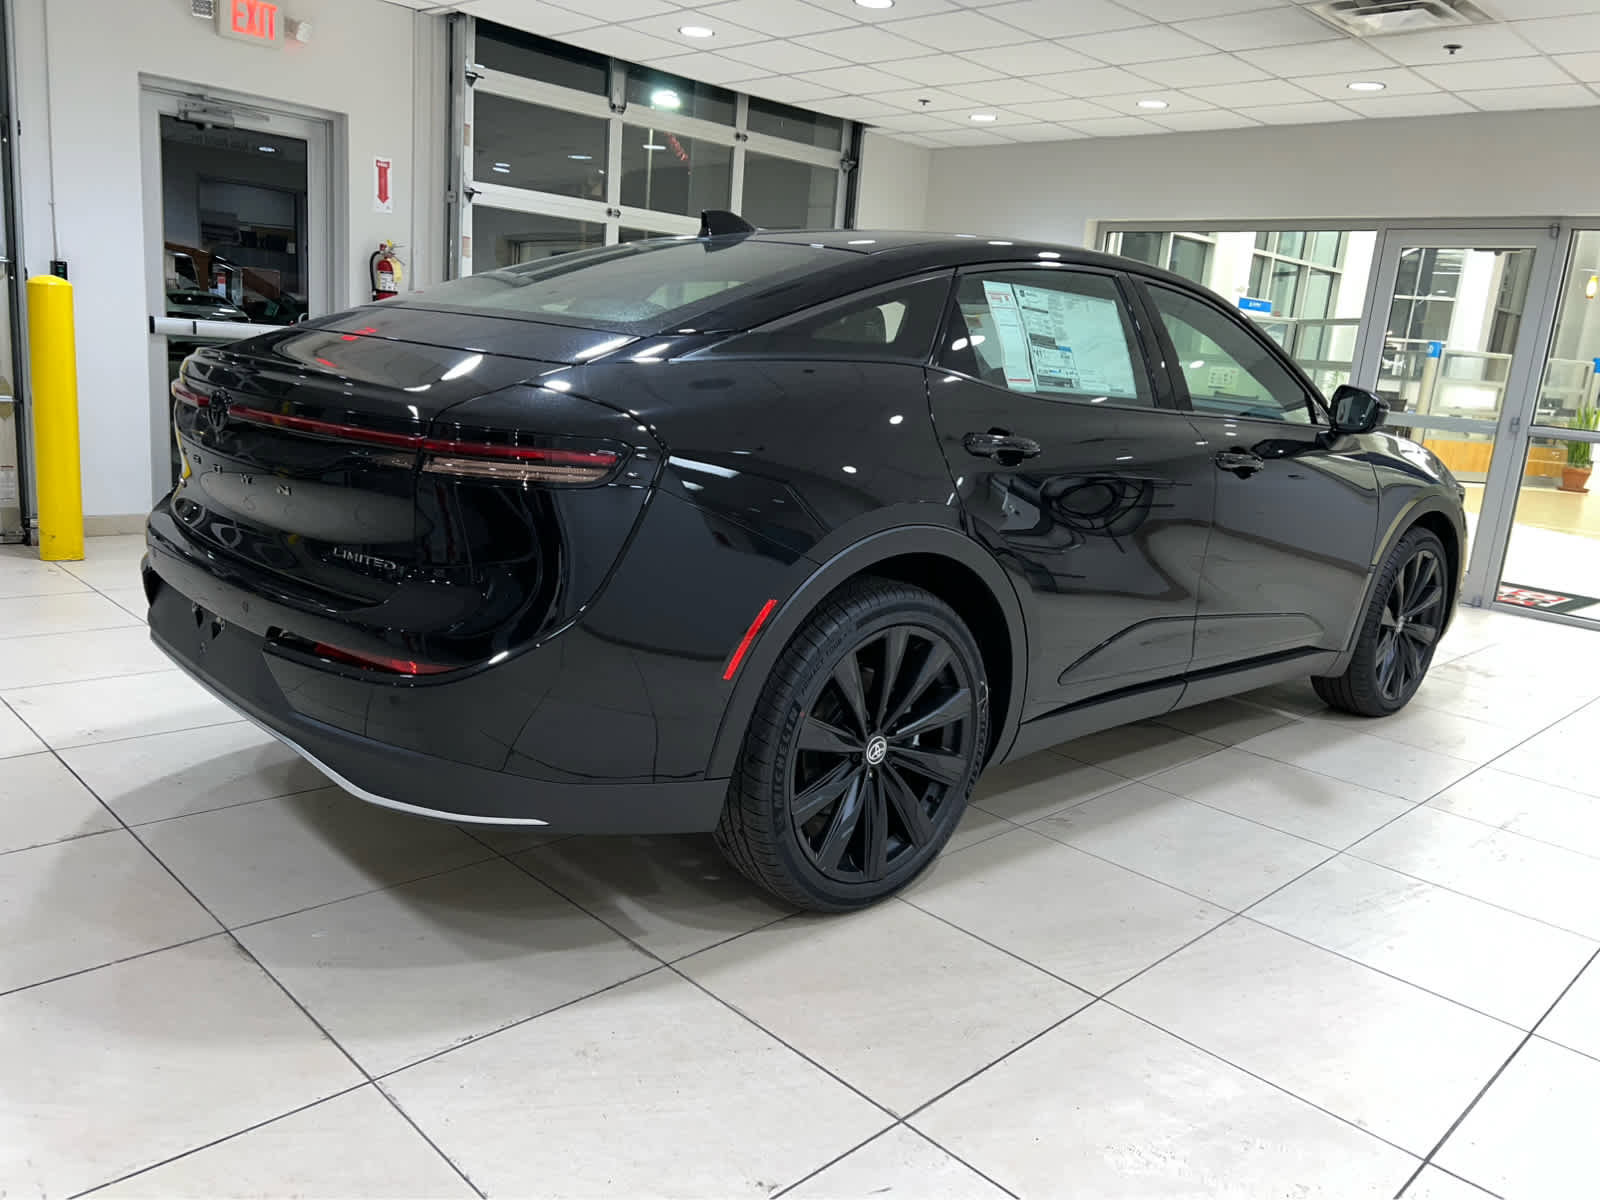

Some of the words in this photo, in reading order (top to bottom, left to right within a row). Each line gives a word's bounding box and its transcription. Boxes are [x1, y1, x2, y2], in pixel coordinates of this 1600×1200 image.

[231, 0, 278, 40] EXIT
[333, 546, 397, 570] LIMITED
[773, 702, 800, 808] MICHELIN
